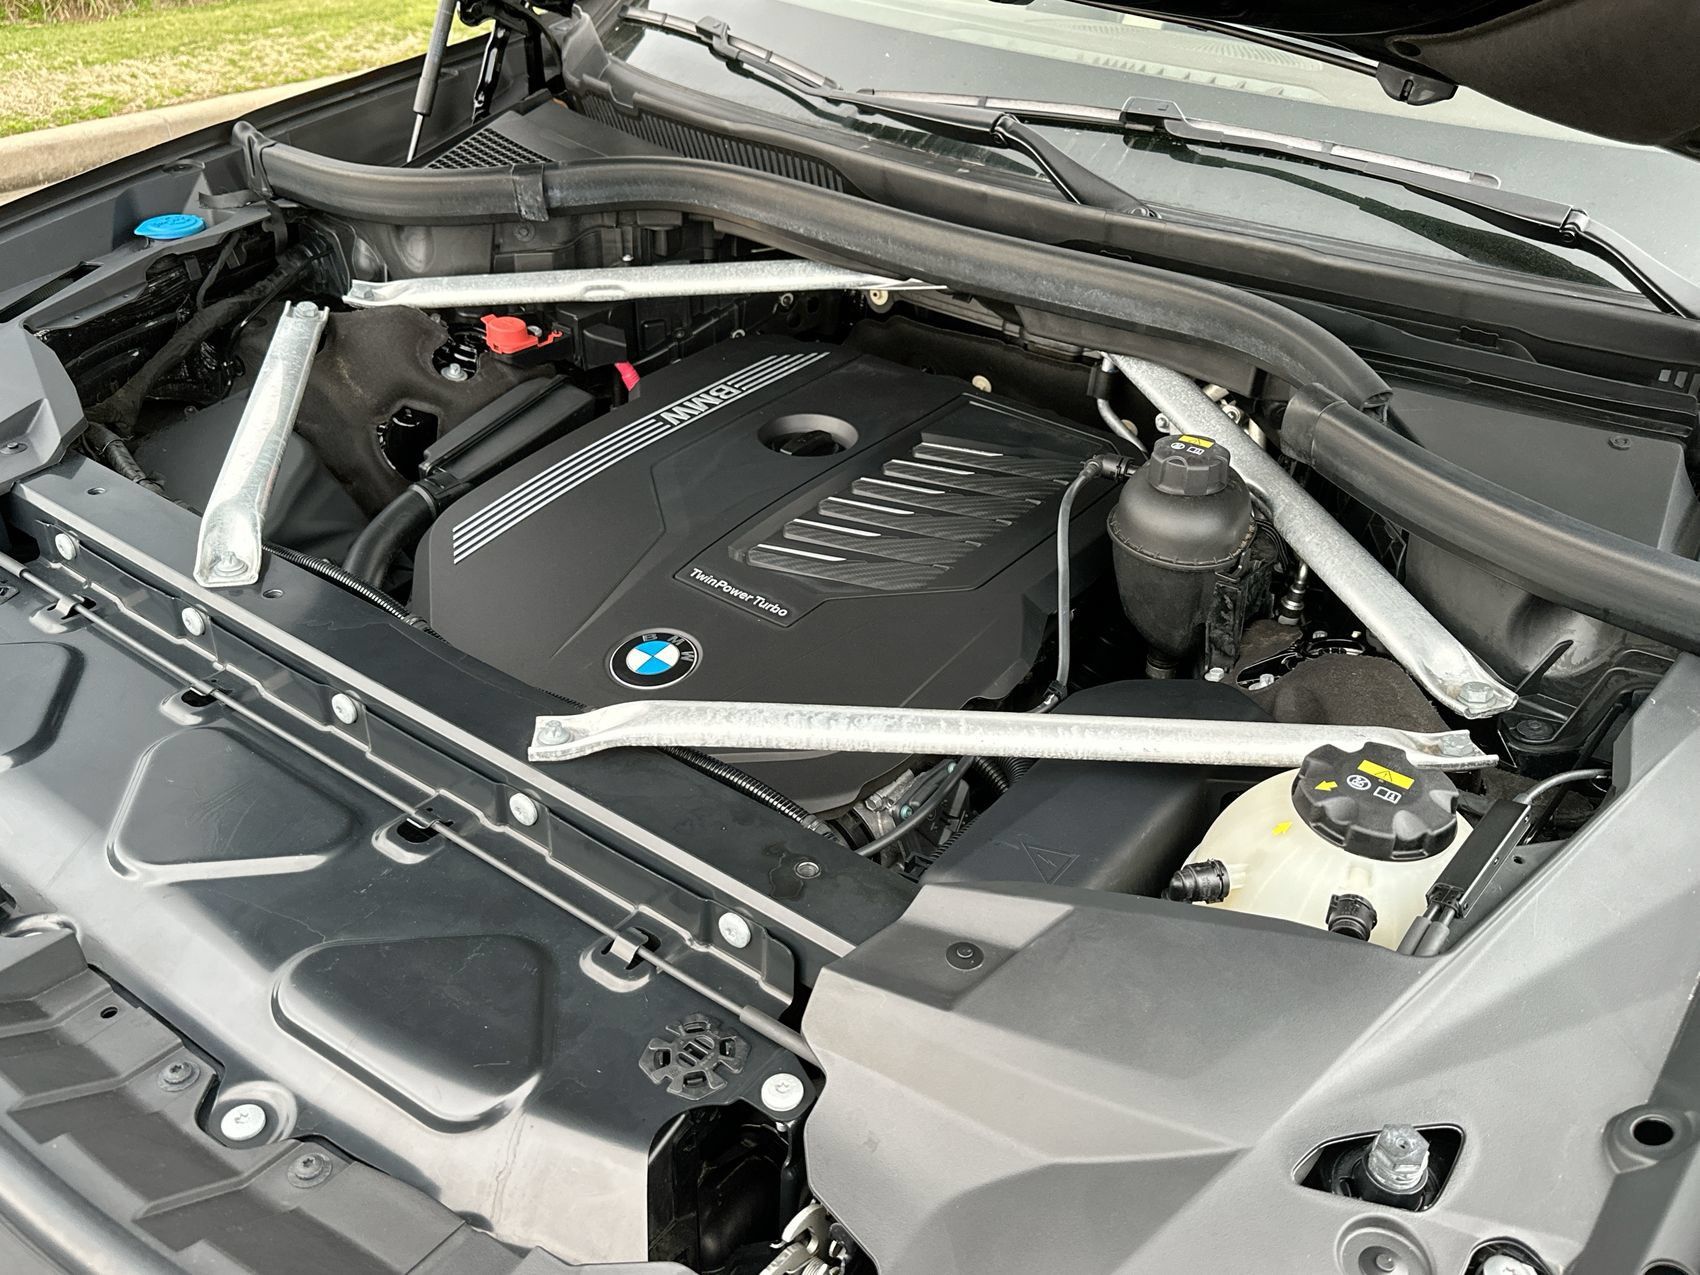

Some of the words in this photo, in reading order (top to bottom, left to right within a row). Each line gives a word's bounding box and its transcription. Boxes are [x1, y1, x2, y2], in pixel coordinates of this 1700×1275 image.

[659, 383, 742, 426] BMW
[689, 567, 754, 602] TwinPower
[751, 595, 788, 618] Turbo
[641, 633, 695, 663] BMW
